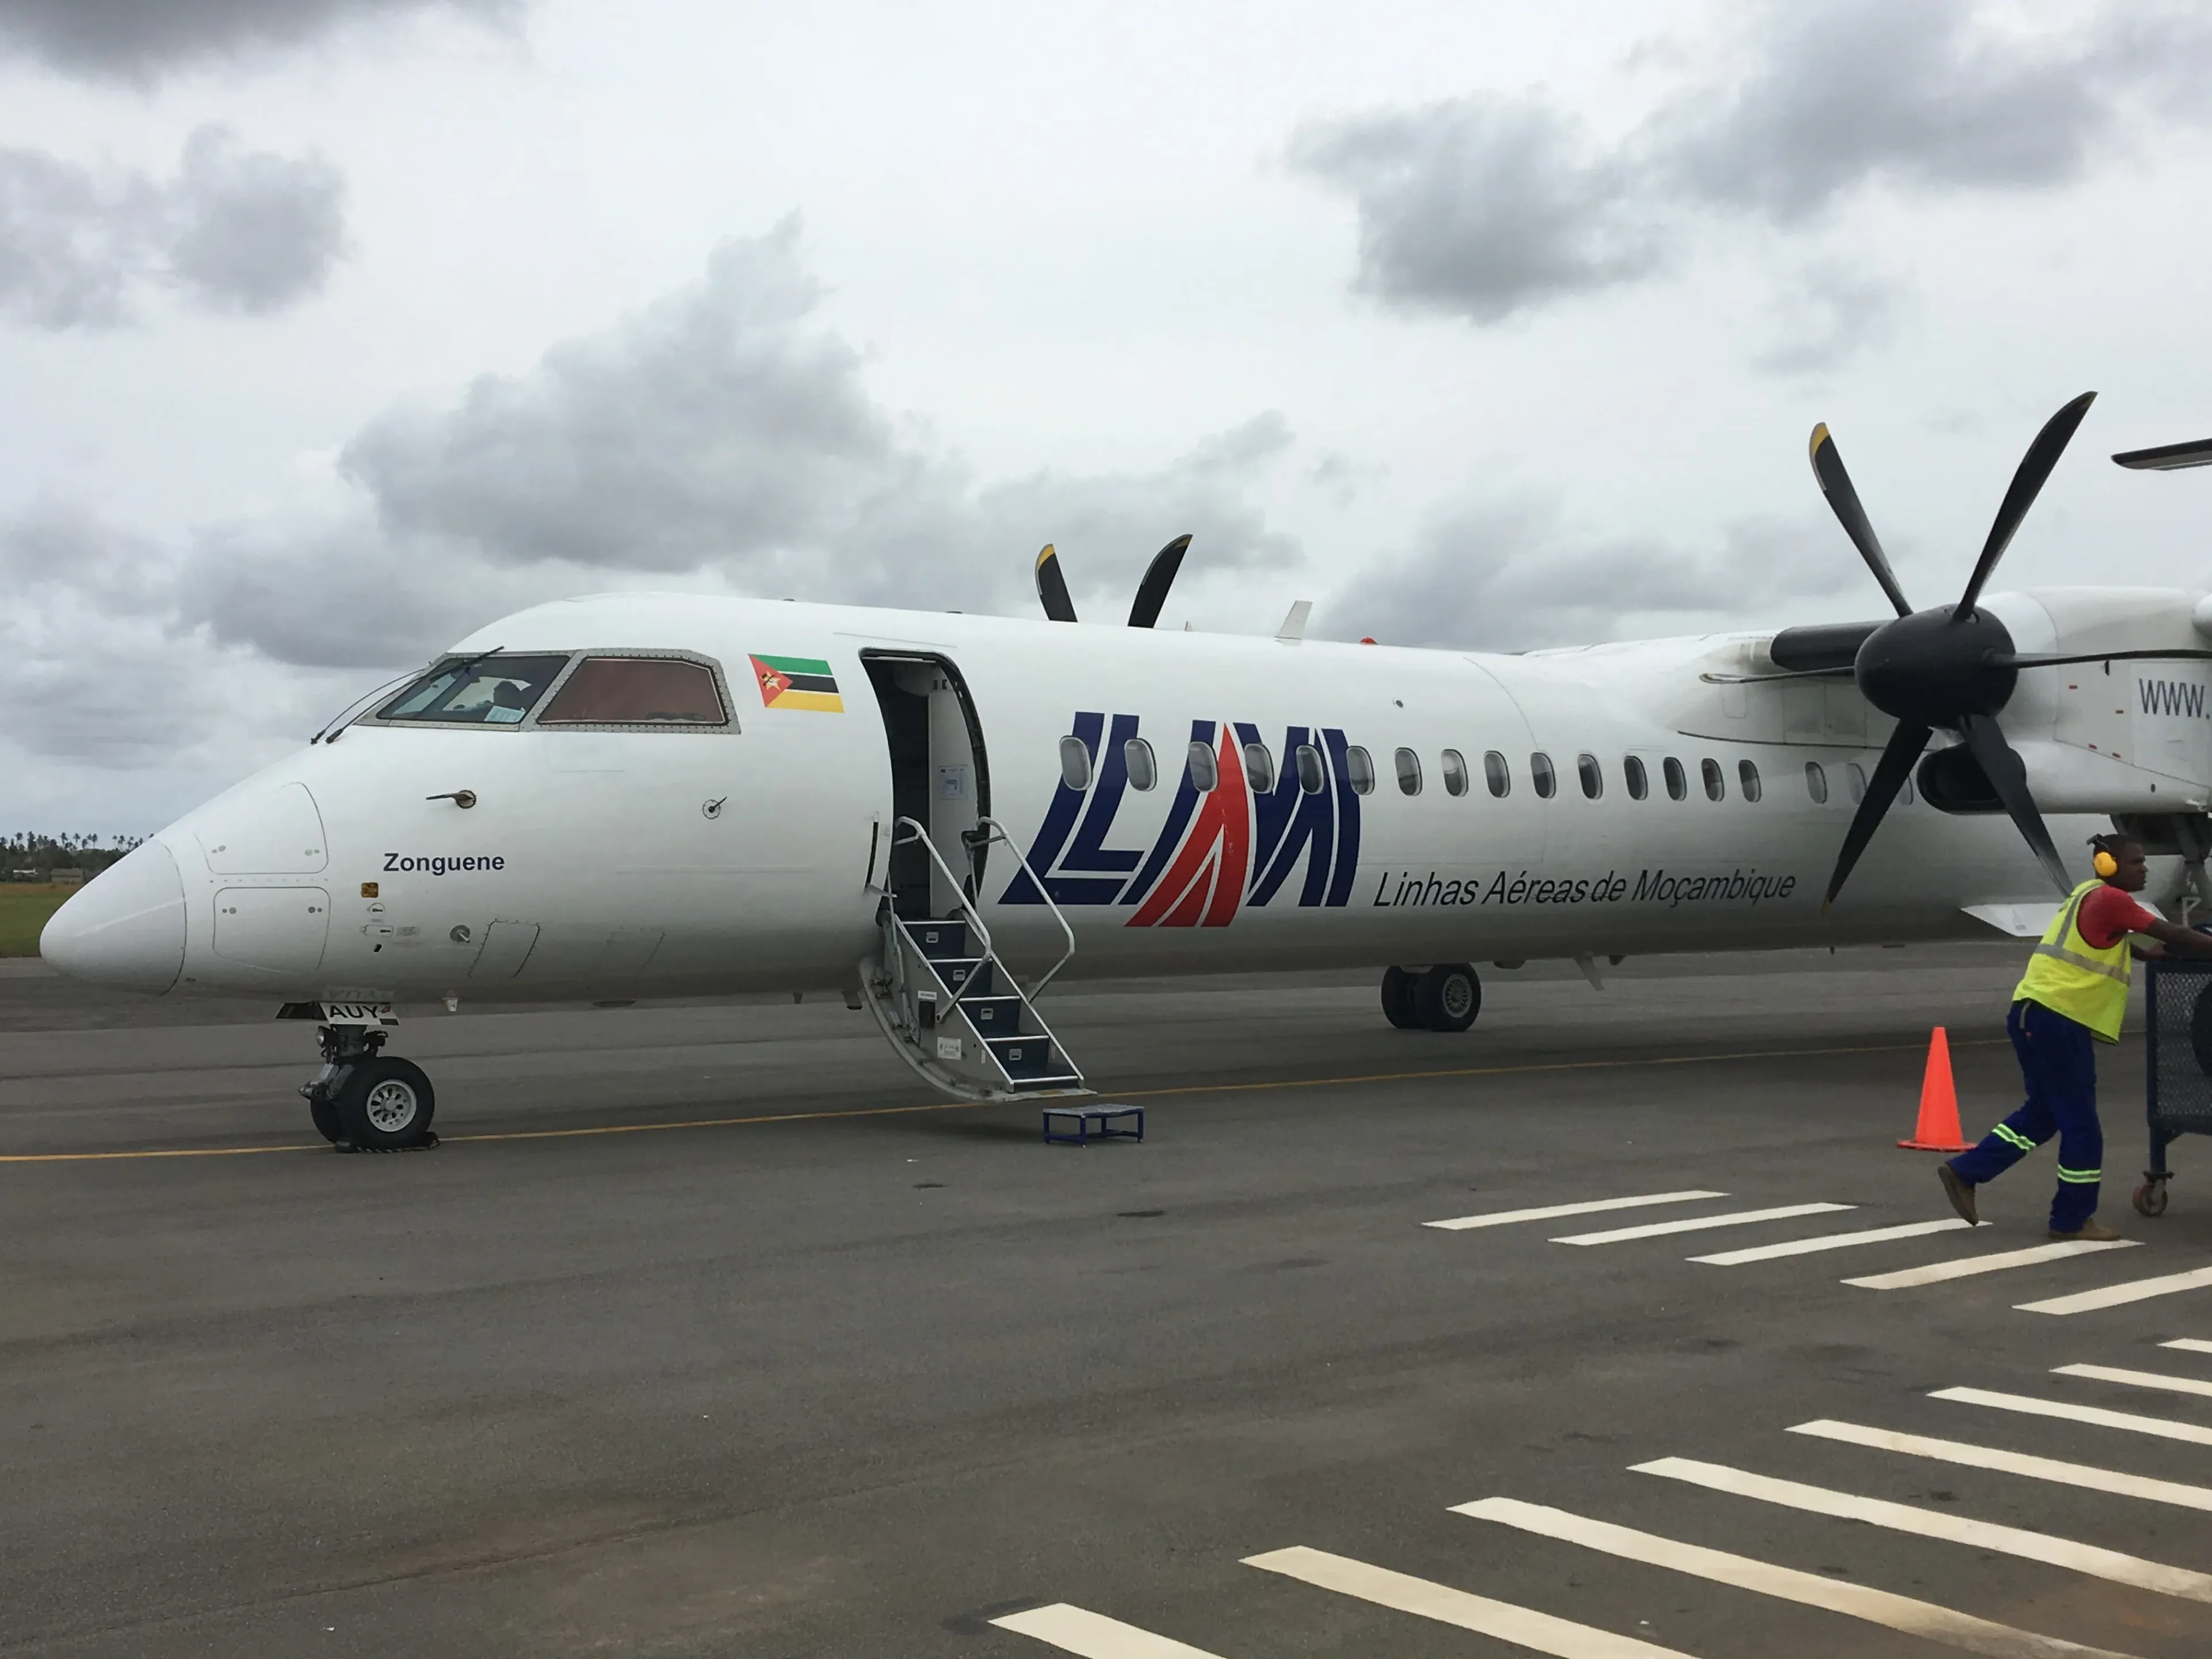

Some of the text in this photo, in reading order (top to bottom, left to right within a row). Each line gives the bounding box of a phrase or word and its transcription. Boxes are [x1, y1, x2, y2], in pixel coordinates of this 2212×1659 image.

[997, 711, 1361, 928] LAM
[383, 853, 505, 876] Zonguene
[1373, 869, 1796, 908] Linhas Aéreas de Moçambique
[329, 1005, 378, 1018] AUY
